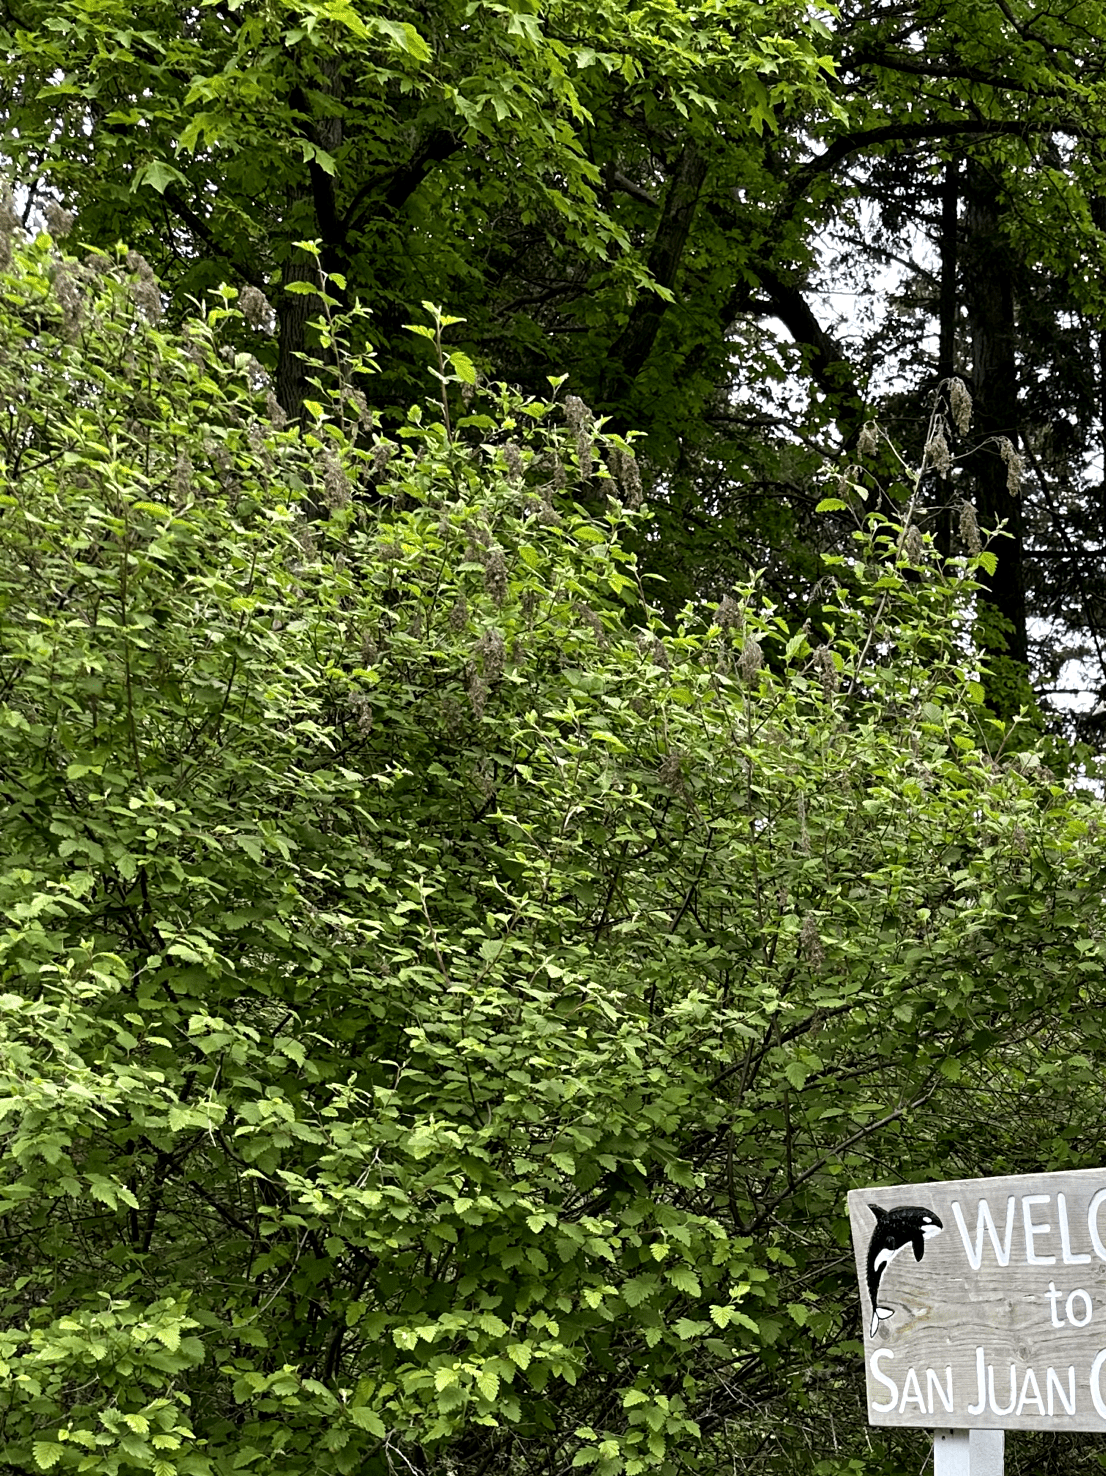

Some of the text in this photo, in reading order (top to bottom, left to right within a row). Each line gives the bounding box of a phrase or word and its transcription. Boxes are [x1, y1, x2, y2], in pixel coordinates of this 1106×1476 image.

[1044, 1281, 1092, 1329] to
[869, 1347, 954, 1414] SAN
[967, 1346, 1075, 1417] JUAN
